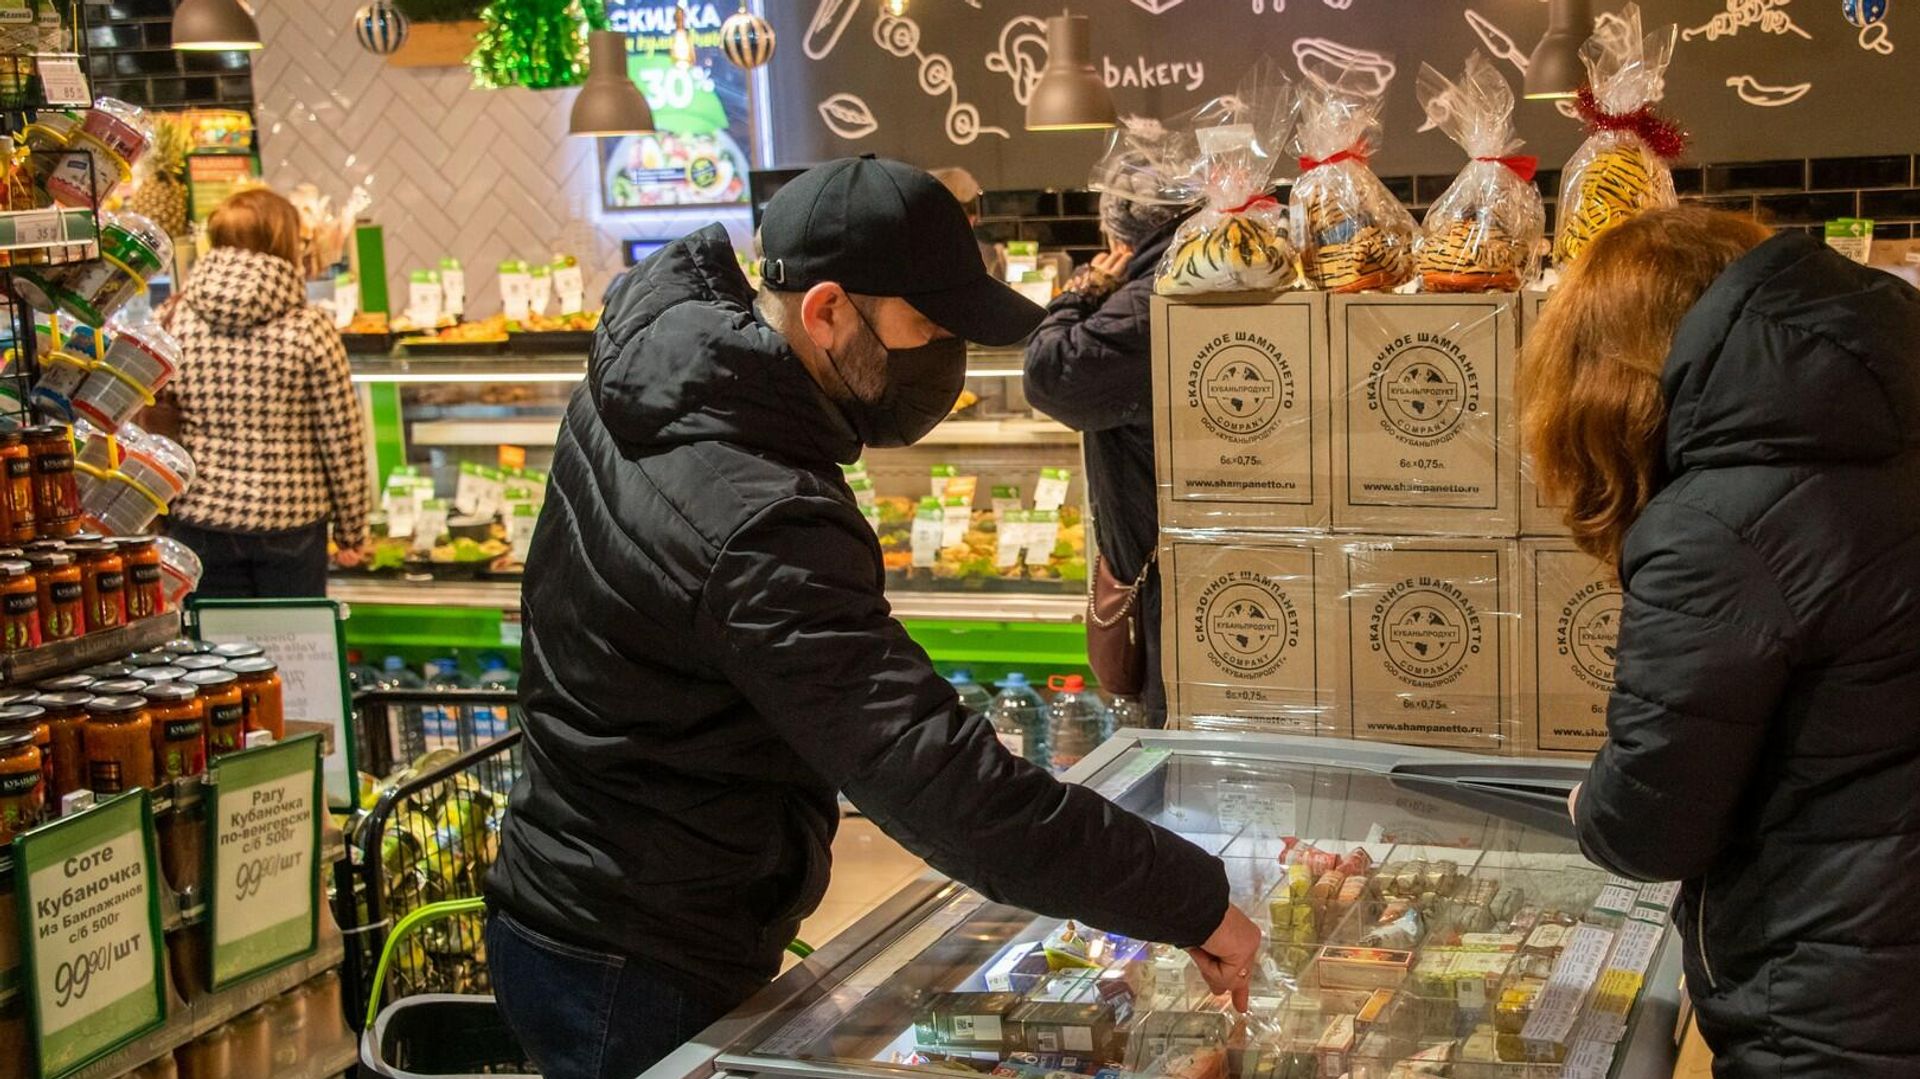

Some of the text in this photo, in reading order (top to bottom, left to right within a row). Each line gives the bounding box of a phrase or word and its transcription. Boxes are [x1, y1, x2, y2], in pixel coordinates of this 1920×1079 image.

[611, 4, 721, 34] СКИДКА
[639, 66, 715, 109] 30%
[1103, 55, 1204, 91] bakery
[1188, 331, 1294, 410] СКАЗОЧНОЕ ШАМПАНЕТТО
[1417, 333, 1479, 412] ШАМПАНЕТТО
[1200, 417, 1216, 433] ООО
[1216, 415, 1265, 431] COMPANY
[1380, 420, 1395, 435] ООО
[1397, 419, 1448, 433] COMPANY
[1186, 479, 1296, 490] www.shampanetto.ru
[1195, 571, 1298, 647] СКАЗОЧНОЕ ШАМПАНЕТТО
[1370, 577, 1481, 654] СКАЗОЧНОЕ ШАМПАНЕТТО
[1557, 581, 1604, 655] СКАЗОЧНОЕ
[1207, 652, 1221, 668] ООО
[1223, 652, 1269, 666] COMPANY
[1383, 660, 1398, 676] ООО
[1400, 660, 1450, 675] COMPANY
[1367, 723, 1482, 733] www.shampanetto.ru
[252, 787, 286, 807] Рагу
[220, 810, 311, 846] по-венгерски
[231, 798, 303, 828] Кубаночка
[242, 827, 297, 854] с/б 500г
[64, 846, 114, 878] Соте
[37, 861, 142, 919] Кубаночка
[39, 883, 143, 939] Из Баклажанов
[69, 911, 120, 944] с/б 500г
